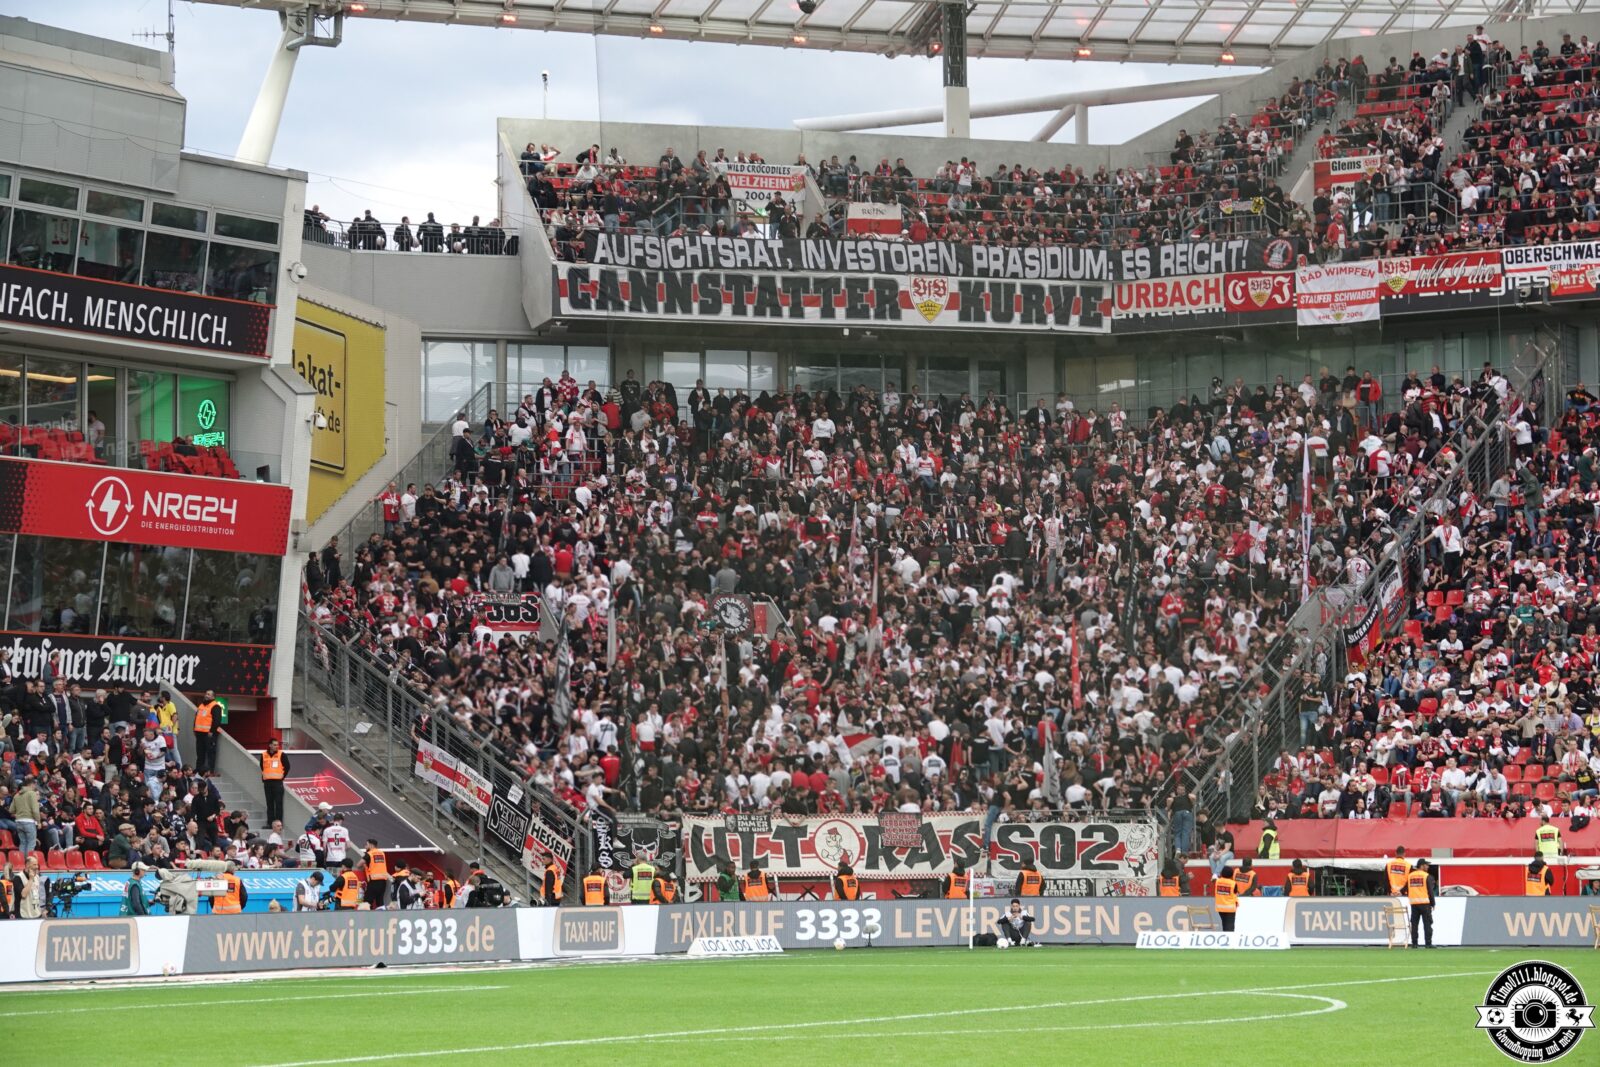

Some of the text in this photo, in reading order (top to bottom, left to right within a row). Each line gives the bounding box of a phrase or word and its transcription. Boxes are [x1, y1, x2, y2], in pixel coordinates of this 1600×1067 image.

[727, 163, 791, 175] WILD CROCODILES
[1331, 161, 1362, 171] Glems
[728, 174, 790, 189] WELZHEIM
[745, 191, 772, 201] 2004
[594, 233, 1248, 281] AUFSICHTSRAT, INVESTOREN, PRÄSIDIUM: ES REICHT!
[1300, 266, 1376, 285] BAD WIMPFEN
[1560, 273, 1586, 287] MTS
[567, 266, 901, 323] CANNSTATTER
[957, 279, 1104, 328] KURVE
[1116, 277, 1221, 312] URBACH
[1300, 294, 1332, 305] STAUFER
[1334, 289, 1376, 304] SCHWABEN
[83, 296, 233, 347] MENSCHLICH.
[142, 489, 238, 524] NRG24
[141, 521, 235, 535] DIE ENERGIEDISTRIBUTION
[98, 641, 200, 687] Anzeiger
[531, 822, 570, 862] HESSEN
[690, 820, 981, 874] ULTRAS
[564, 920, 615, 943] TAXI-RUF
[670, 909, 785, 944] TAXI-RUF
[795, 908, 882, 941] 3333
[1302, 911, 1388, 932] TAXI-RUF
[52, 935, 126, 962] TAXI-RUF
[216, 916, 495, 962] www.taxiruf3333.de
